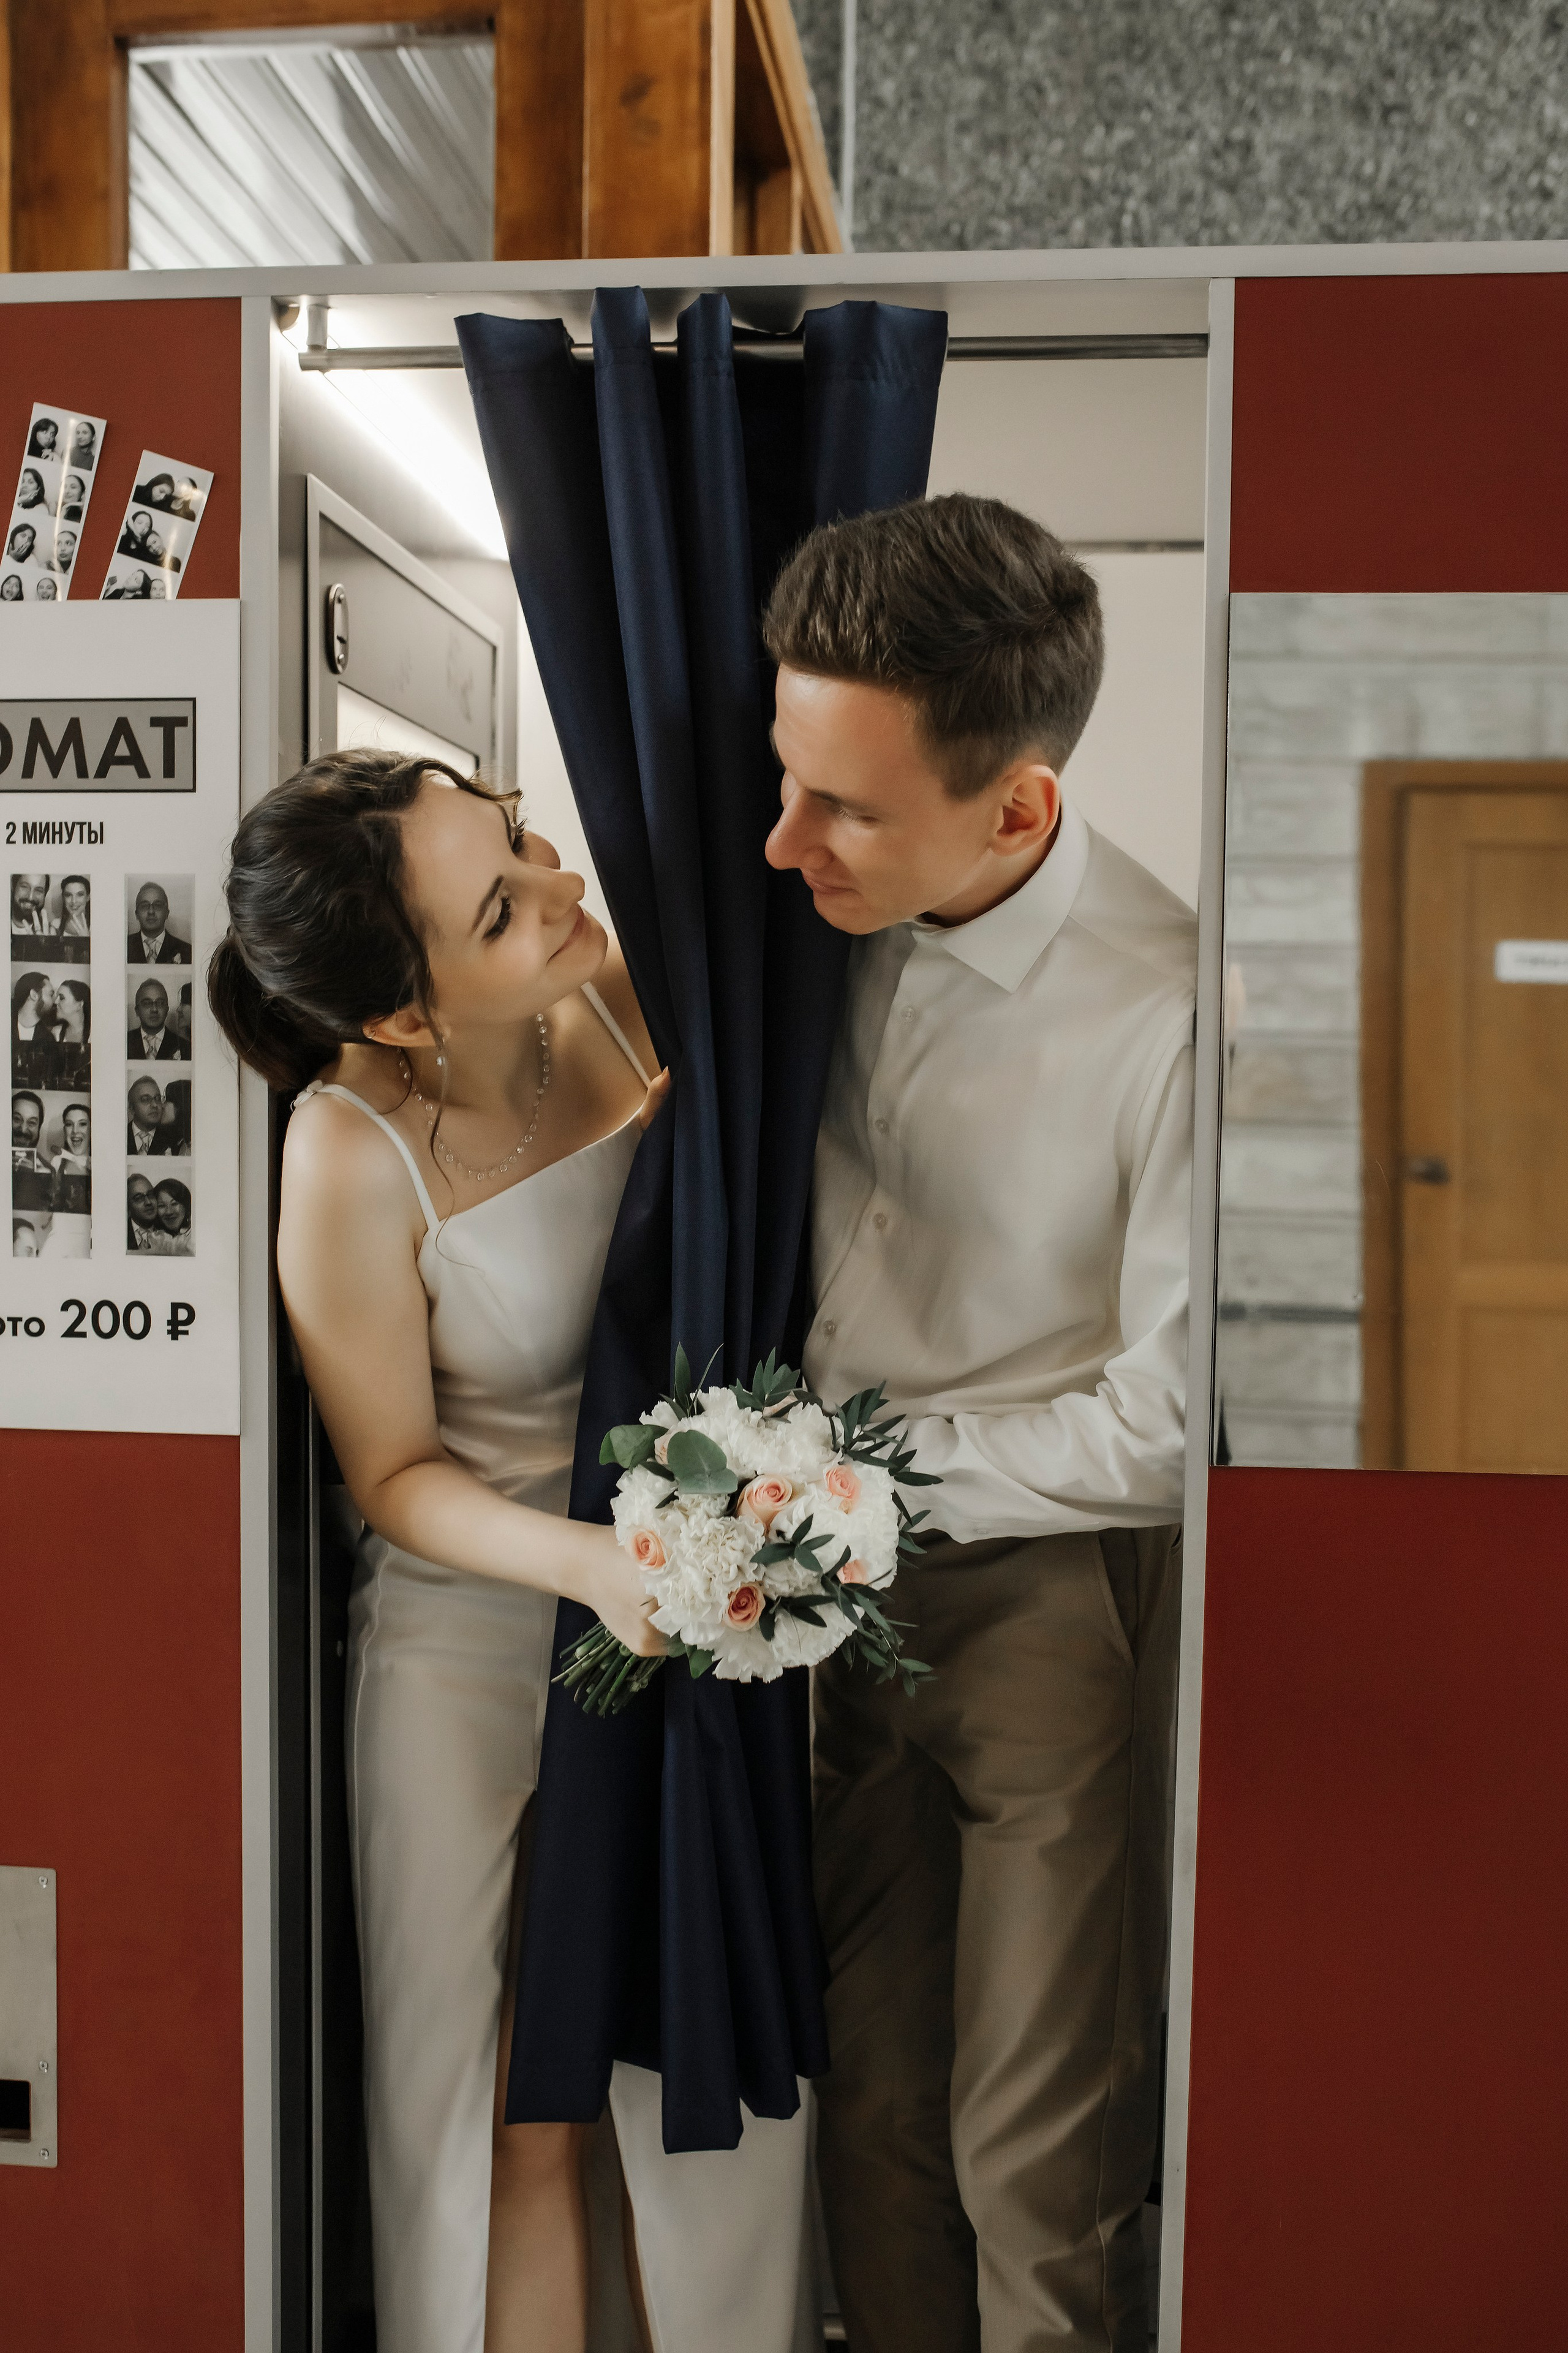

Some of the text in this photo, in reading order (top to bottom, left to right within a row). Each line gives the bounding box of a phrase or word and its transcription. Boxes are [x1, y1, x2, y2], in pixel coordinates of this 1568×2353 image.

[0, 716, 189, 779] МАТ
[6, 821, 104, 845] 2 МИНУТЫ
[0, 1316, 45, 1337] то
[60, 1299, 152, 1340] 200
